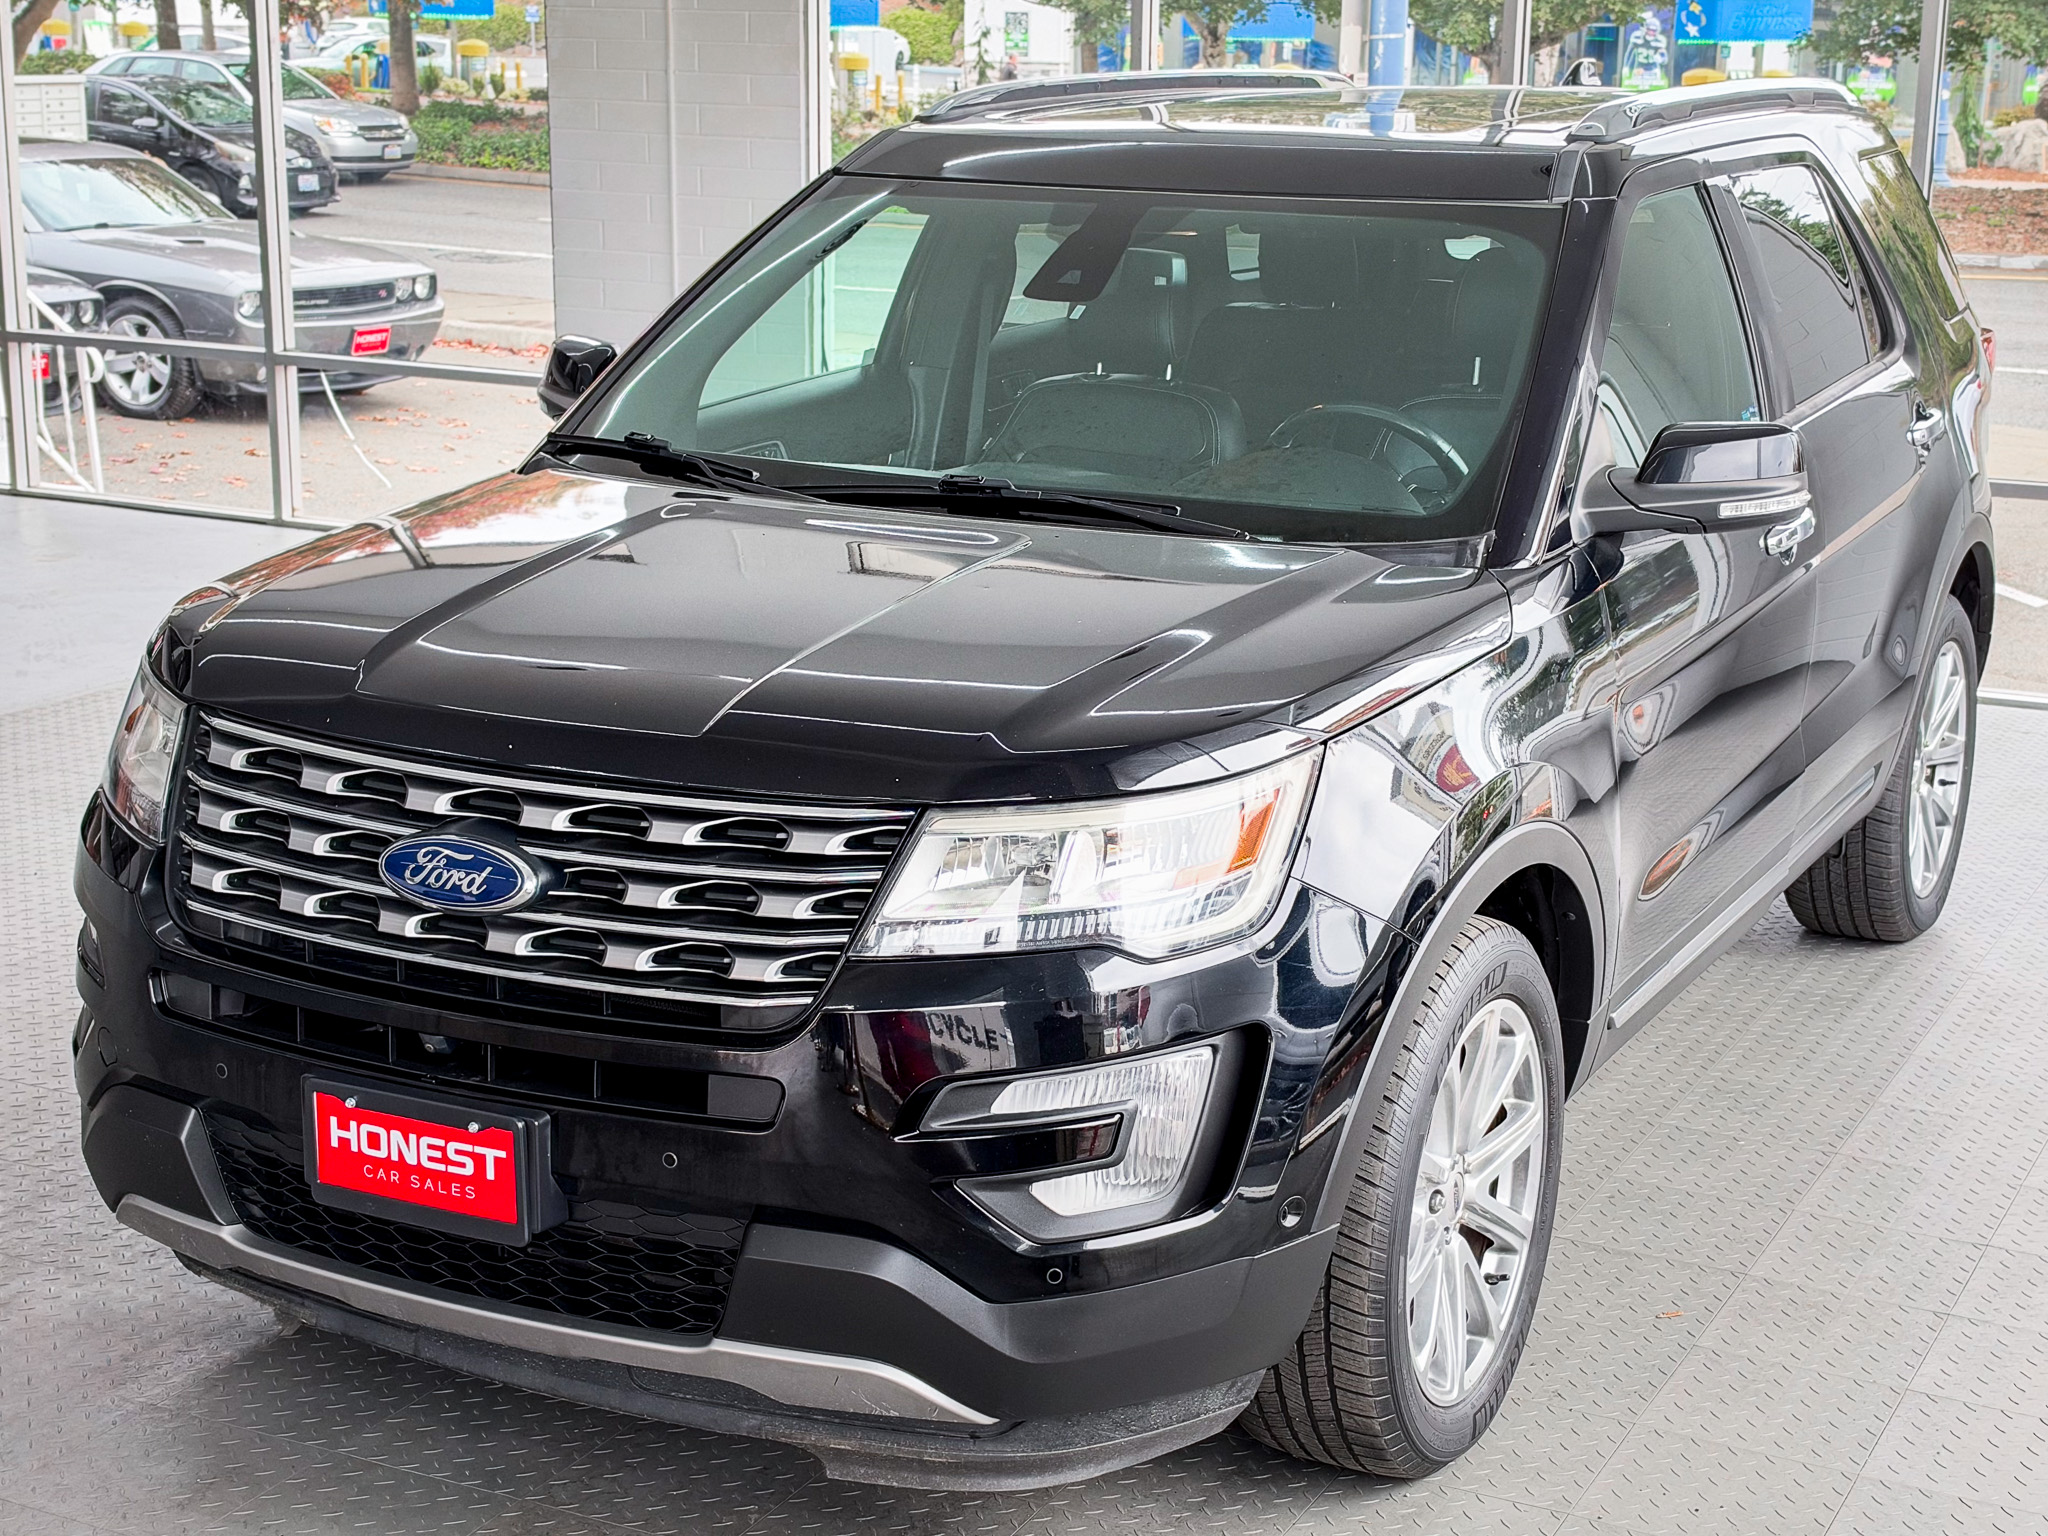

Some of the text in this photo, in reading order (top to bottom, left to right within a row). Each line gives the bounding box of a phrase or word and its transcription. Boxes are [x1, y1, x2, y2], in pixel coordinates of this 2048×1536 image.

[356, 332, 388, 344] HONEST
[404, 846, 493, 895] Ford
[927, 1012, 999, 1051] CYCLE
[329, 1116, 506, 1181] HONEST
[363, 1165, 476, 1199] CAR SALES
